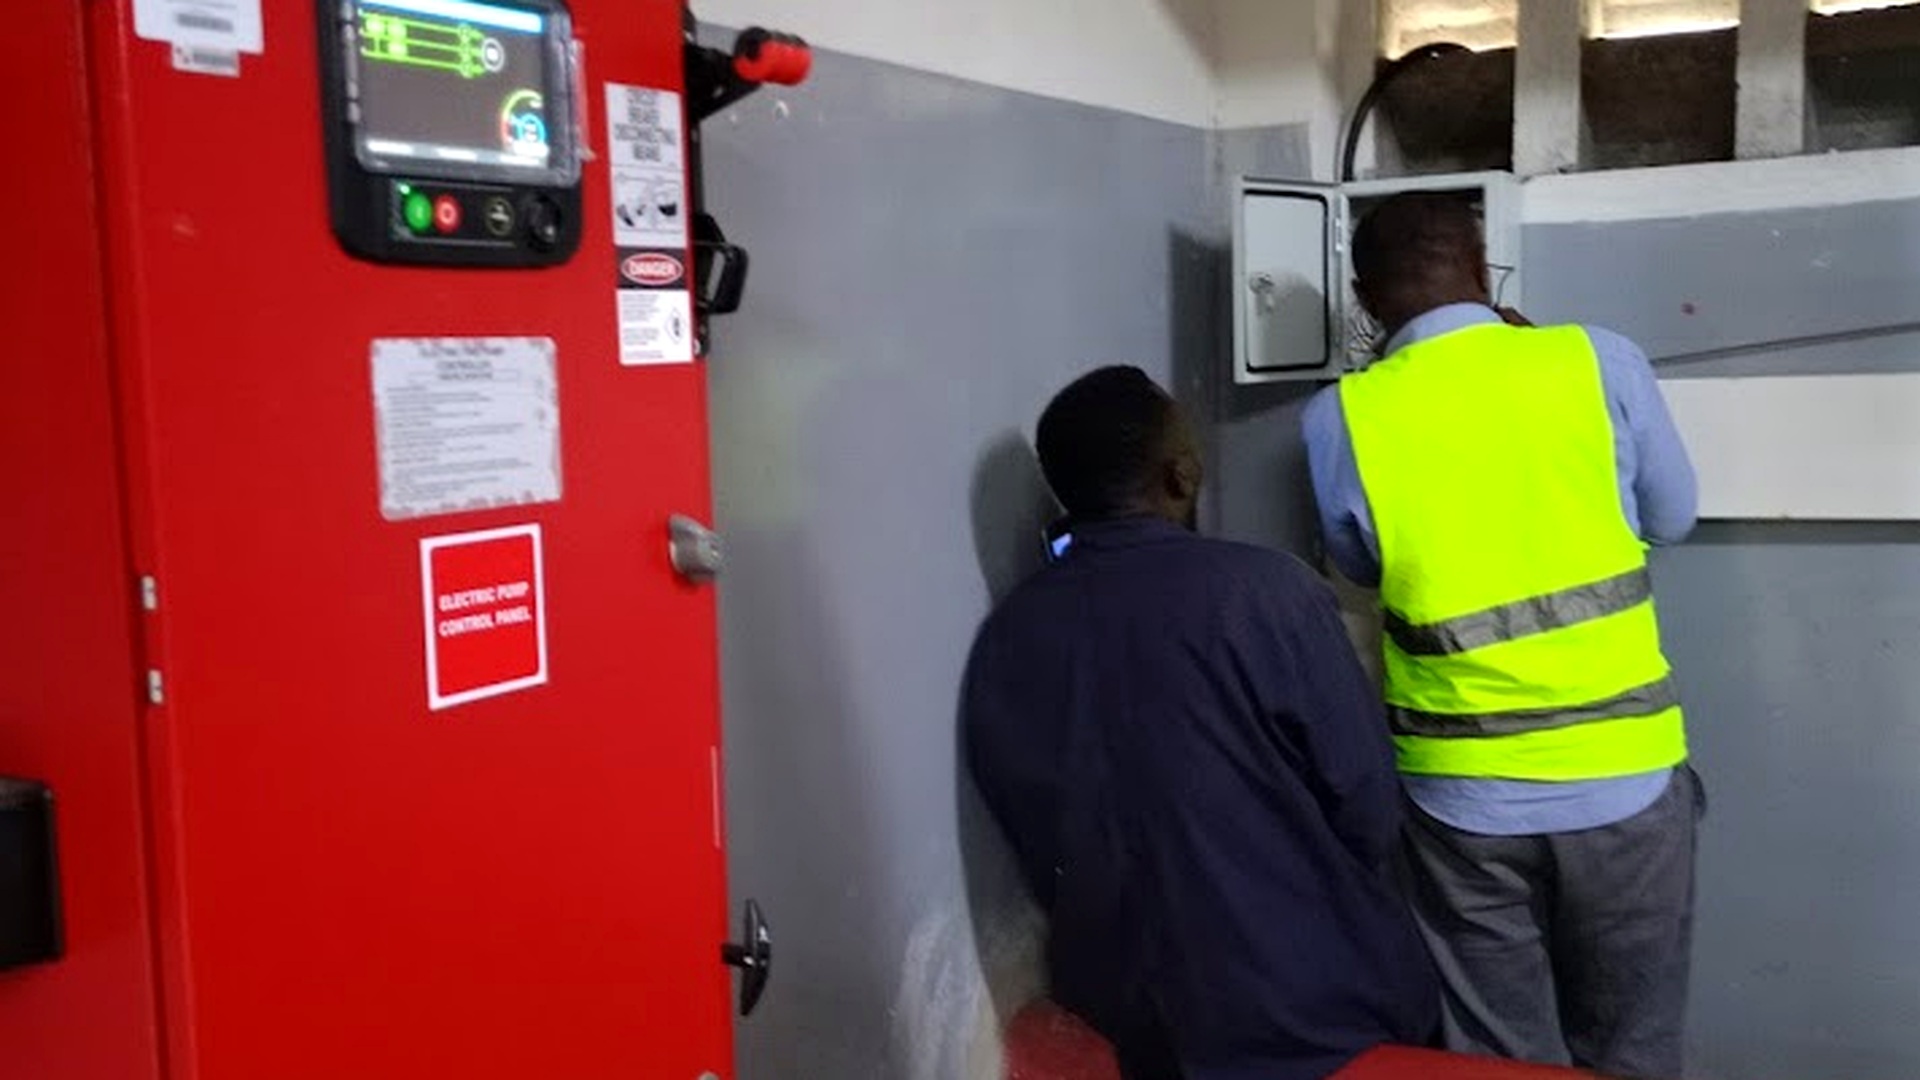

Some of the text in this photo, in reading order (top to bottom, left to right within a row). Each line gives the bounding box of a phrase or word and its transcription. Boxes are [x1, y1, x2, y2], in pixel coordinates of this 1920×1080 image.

[629, 260, 677, 277] DANGER
[439, 581, 530, 612] ELECTRIC PUMP
[439, 606, 532, 637] CONTROL PANEL
